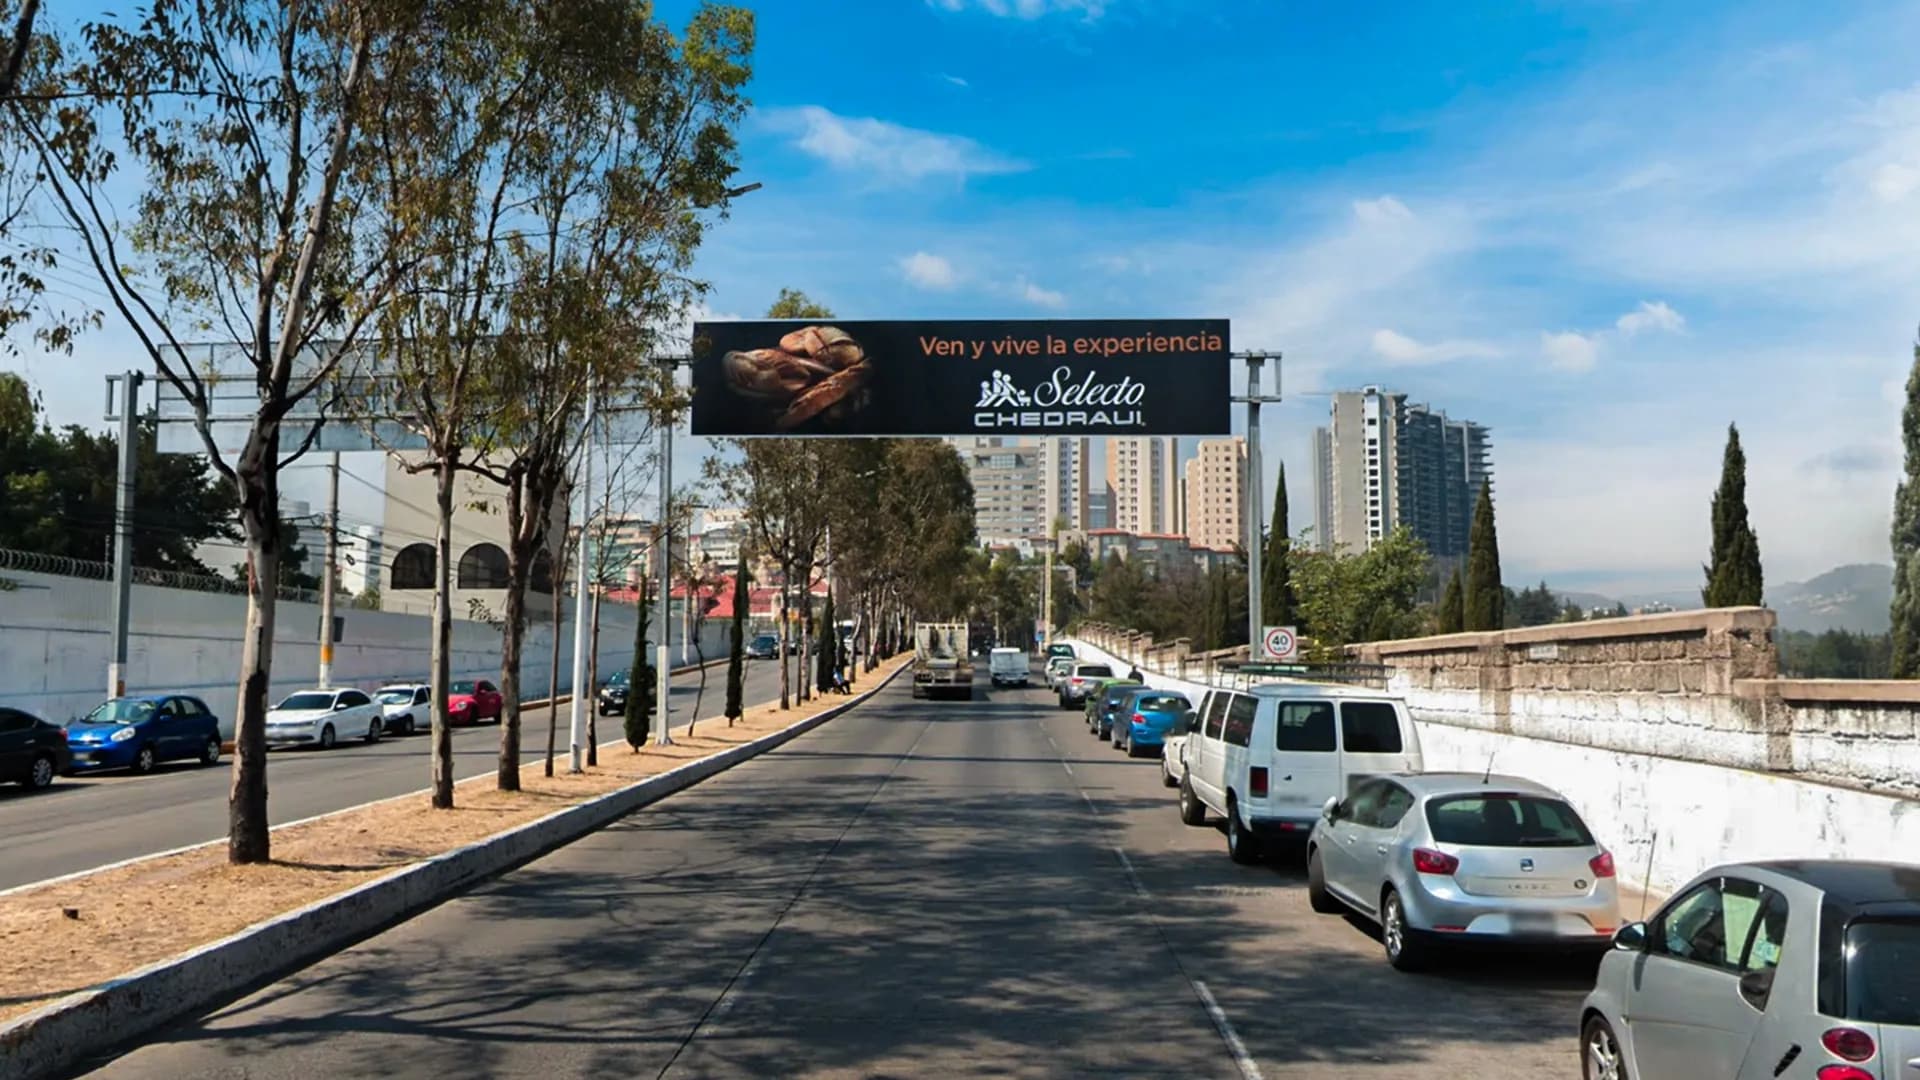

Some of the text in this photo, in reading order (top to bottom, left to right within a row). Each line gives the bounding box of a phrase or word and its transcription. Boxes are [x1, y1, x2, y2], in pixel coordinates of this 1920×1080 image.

[920, 330, 1223, 360] Ven y vive la experiencia
[1033, 365, 1146, 407] Selecto
[974, 411, 1143, 427] CHEDRAUI
[1272, 635, 1289, 645] 40
